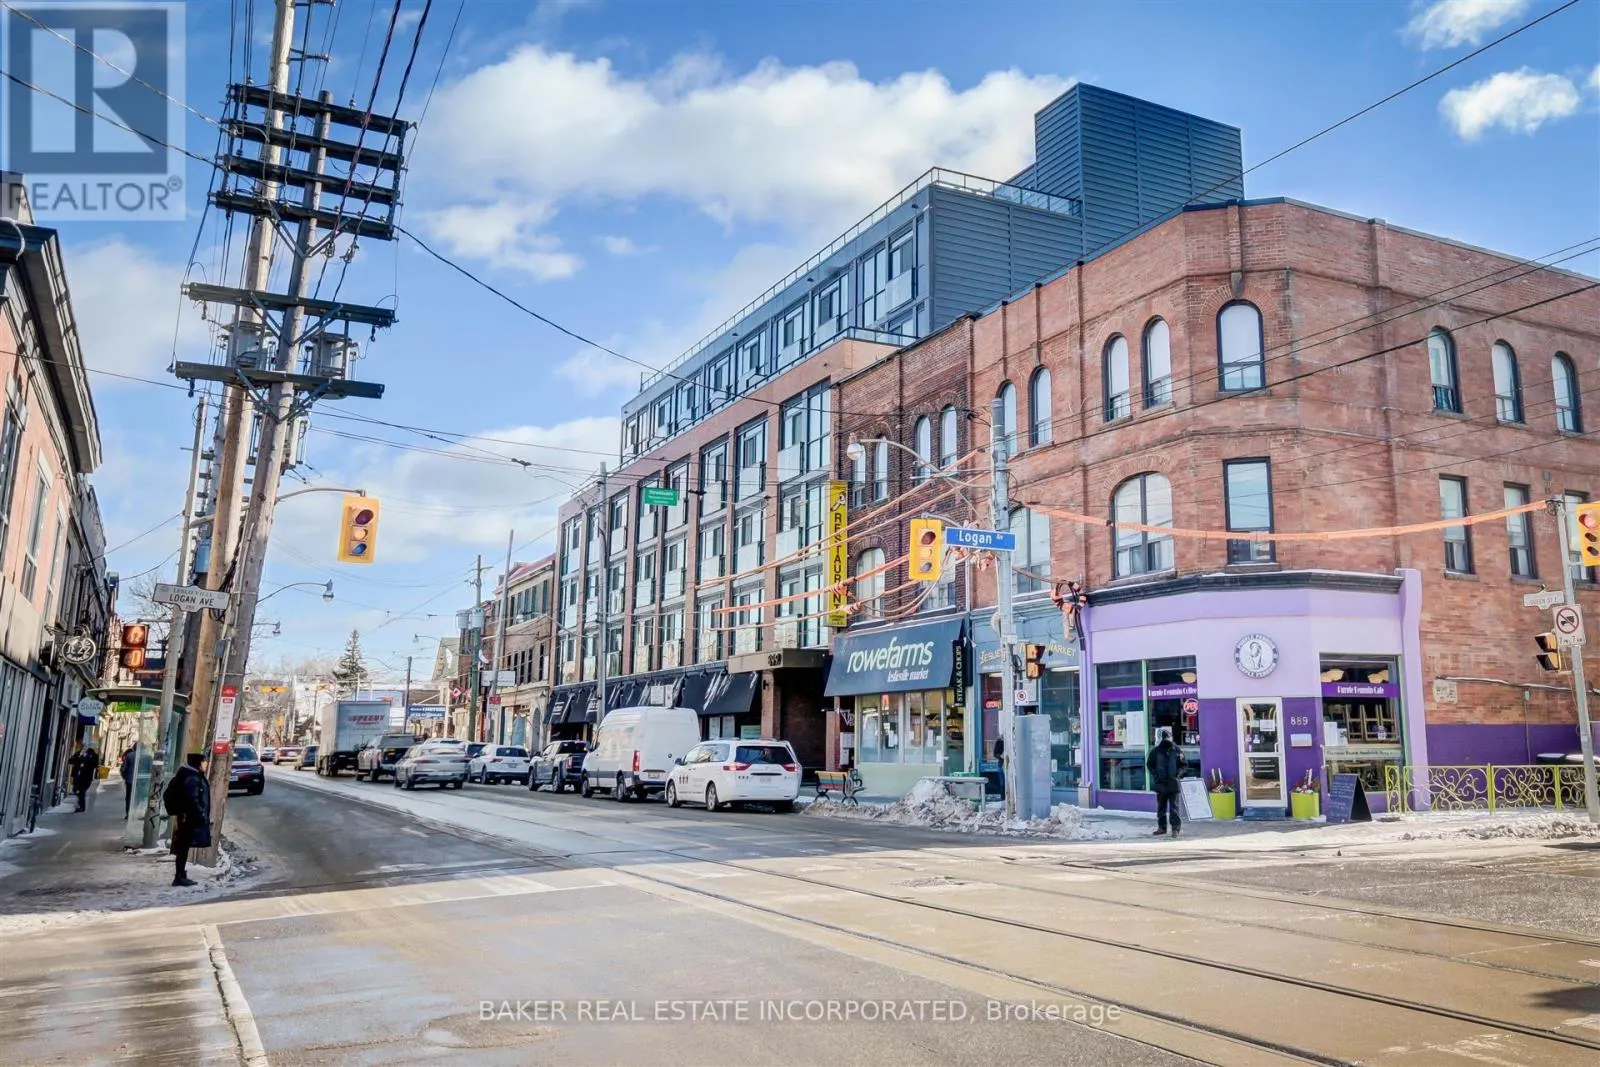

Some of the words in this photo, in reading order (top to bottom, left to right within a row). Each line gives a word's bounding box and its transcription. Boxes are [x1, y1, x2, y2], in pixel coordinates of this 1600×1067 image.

[959, 530, 992, 545] Logan
[833, 512, 842, 612] RESTAURNT
[169, 593, 197, 604] LOGAN
[199, 598, 215, 607] AVE
[847, 636, 935, 673] rowefarms
[1290, 716, 1308, 726] 889
